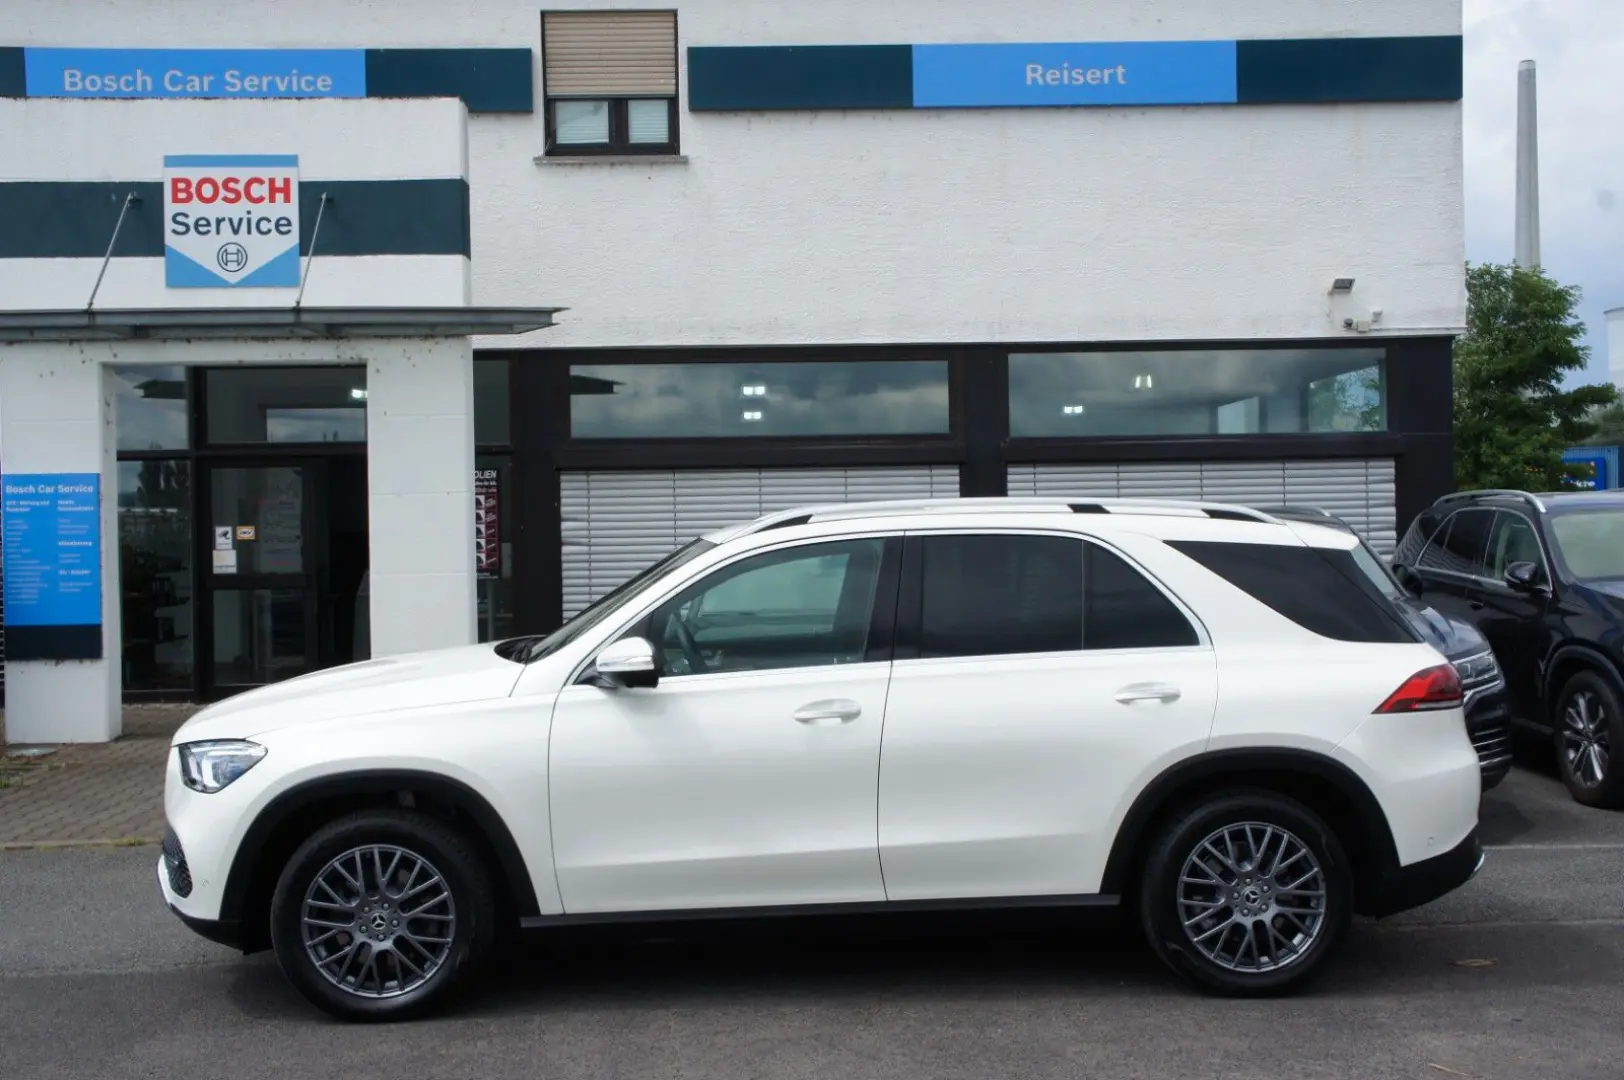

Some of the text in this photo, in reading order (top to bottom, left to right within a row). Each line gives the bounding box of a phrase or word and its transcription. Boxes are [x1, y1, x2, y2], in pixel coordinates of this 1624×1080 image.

[63, 68, 333, 93] Bosch Car Service
[1025, 62, 1127, 86] Reisert
[171, 177, 291, 204] BOSCH
[171, 210, 293, 236] Service
[6, 484, 94, 494] Bosch Car Service
